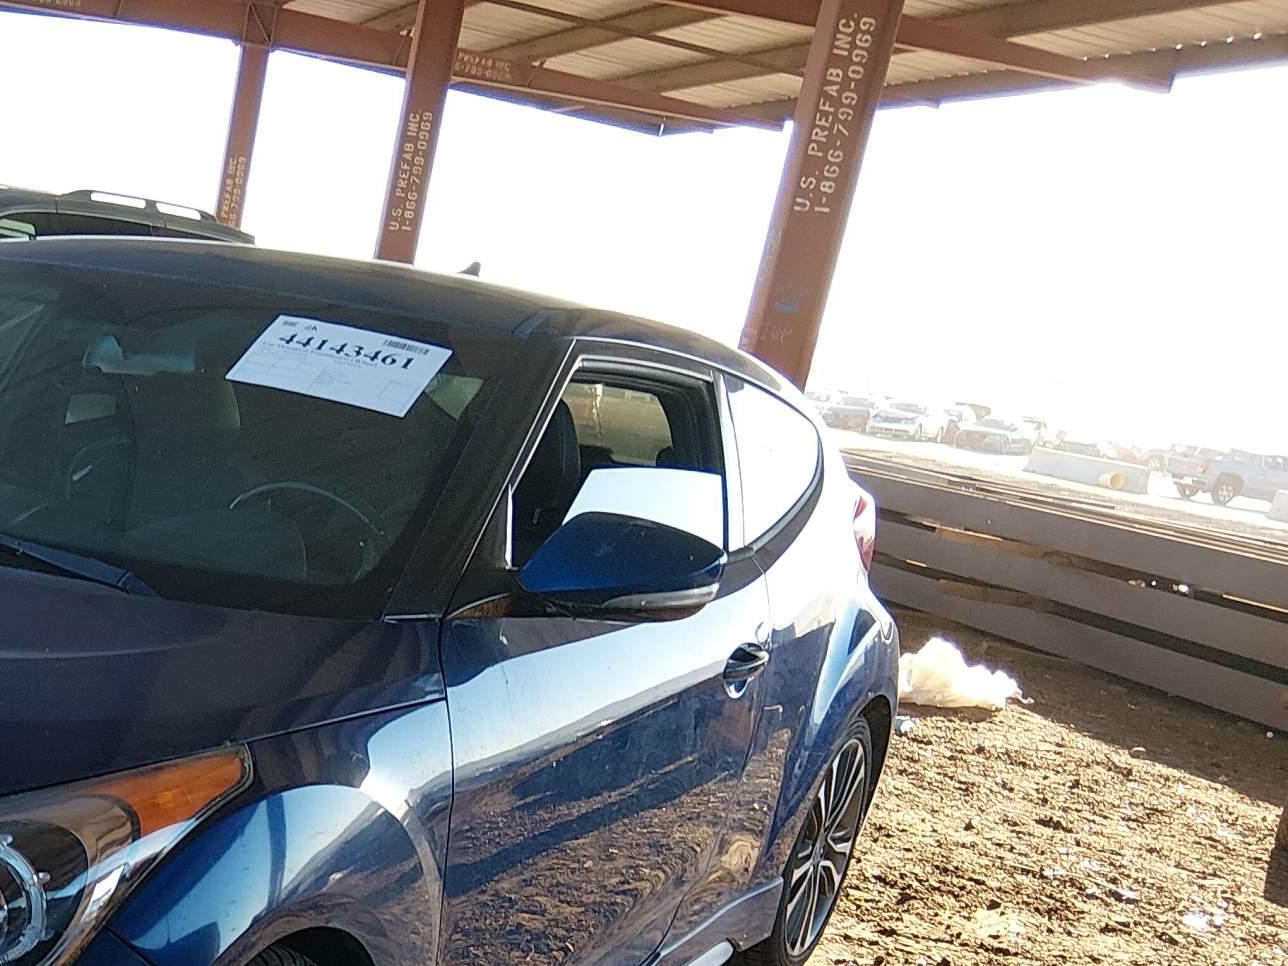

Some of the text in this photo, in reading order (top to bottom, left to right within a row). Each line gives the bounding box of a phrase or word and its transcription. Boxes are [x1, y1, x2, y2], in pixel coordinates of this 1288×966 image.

[389, 109, 422, 231] U.S. PREFAB INC.
[401, 111, 433, 231] 1-866-799-0969
[794, 13, 858, 211] U.S. PREFAB INC.
[814, 16, 876, 213] 1-866-799-0969
[279, 333, 414, 370] 44143461
